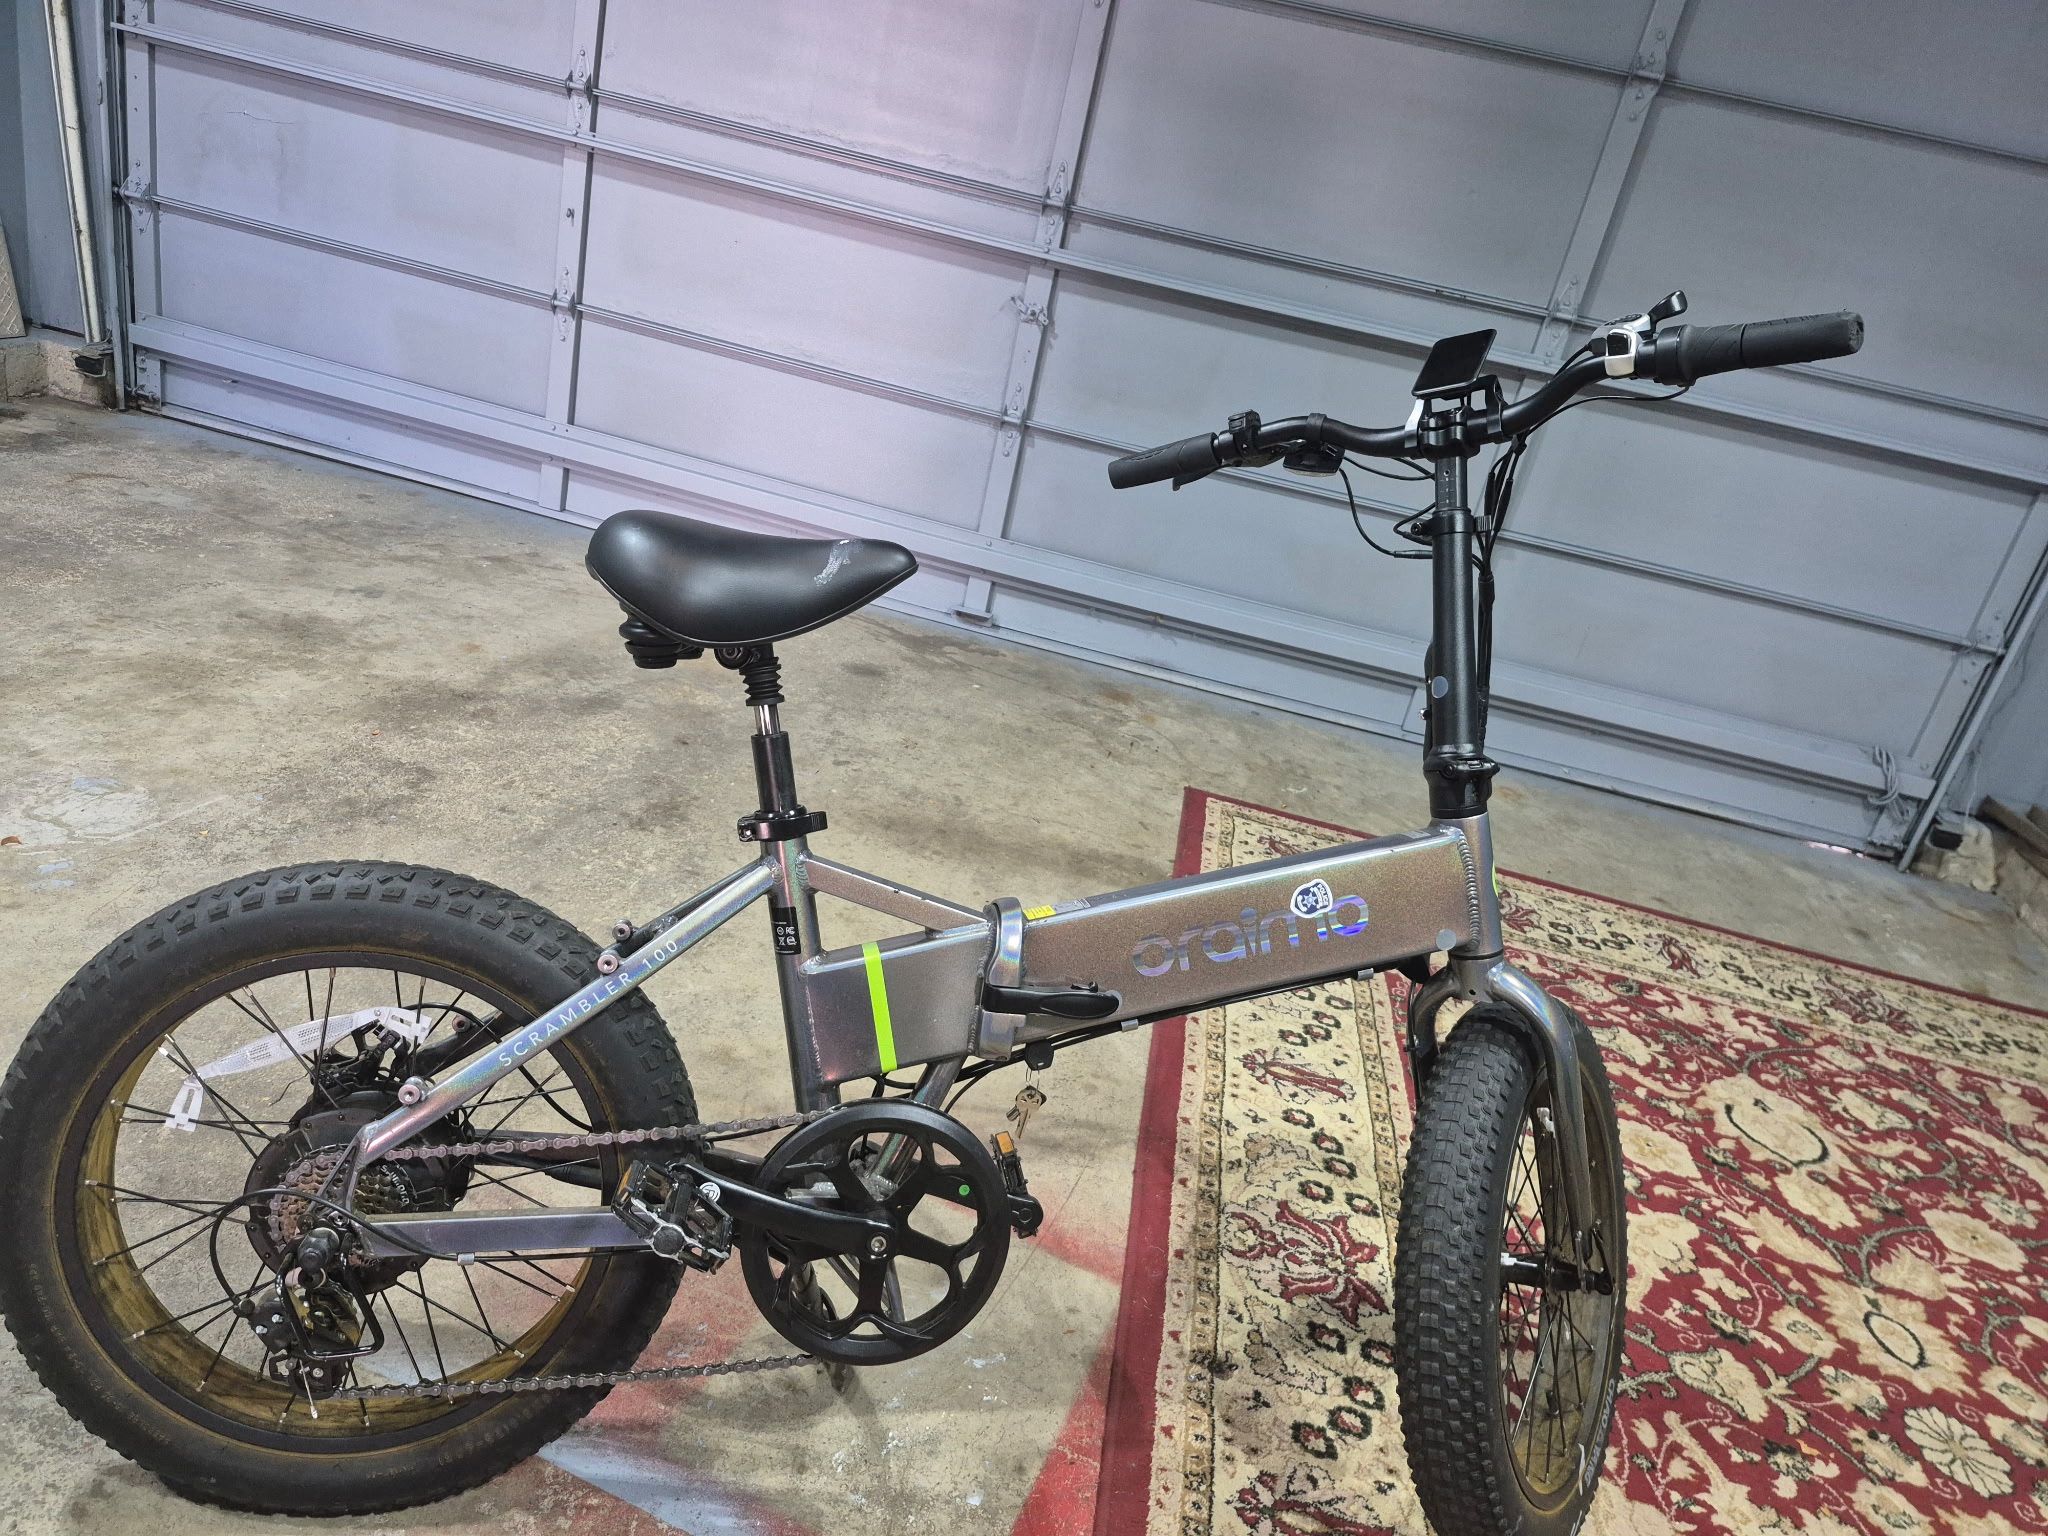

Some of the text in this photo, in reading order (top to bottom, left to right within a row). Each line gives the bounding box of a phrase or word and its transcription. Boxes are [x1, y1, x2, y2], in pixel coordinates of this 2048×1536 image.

[1132, 894, 1369, 977] oraimo
[1317, 884, 1329, 906] POLICE
[499, 940, 678, 1067] SCRAMBLER 100
